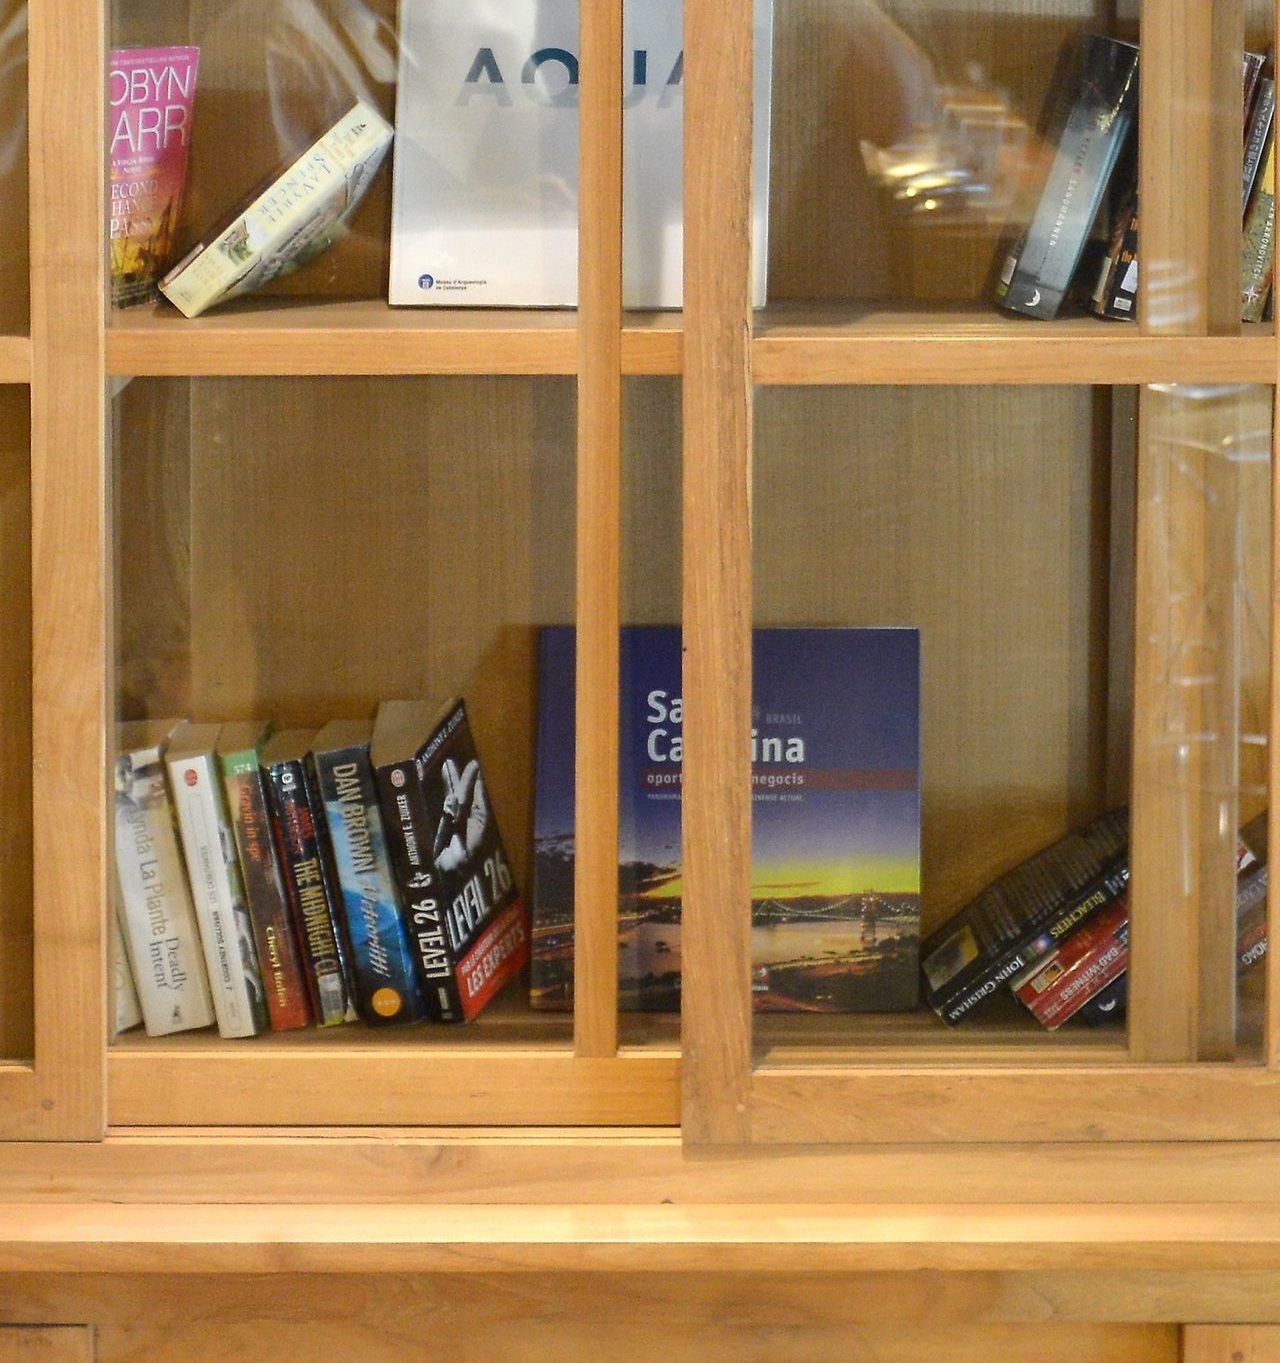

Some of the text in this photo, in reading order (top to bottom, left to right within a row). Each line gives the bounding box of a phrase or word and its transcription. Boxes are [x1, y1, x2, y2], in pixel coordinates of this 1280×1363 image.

[111, 105, 186, 153] ARR
[766, 714, 802, 725] BRASIL
[332, 762, 376, 874] DAN BROWN
[404, 832, 420, 867] ANTHONY
[139, 859, 167, 936] La Plante
[294, 857, 332, 959] THE MIDNIGHT
[446, 878, 490, 953] LEVEL
[149, 940, 169, 990] Intent
[165, 937, 187, 992] Deadly
[266, 926, 282, 970] Cheryl
[411, 897, 451, 980] LEVEL 26
[949, 954, 1025, 1022] JOHN GRISHAM
